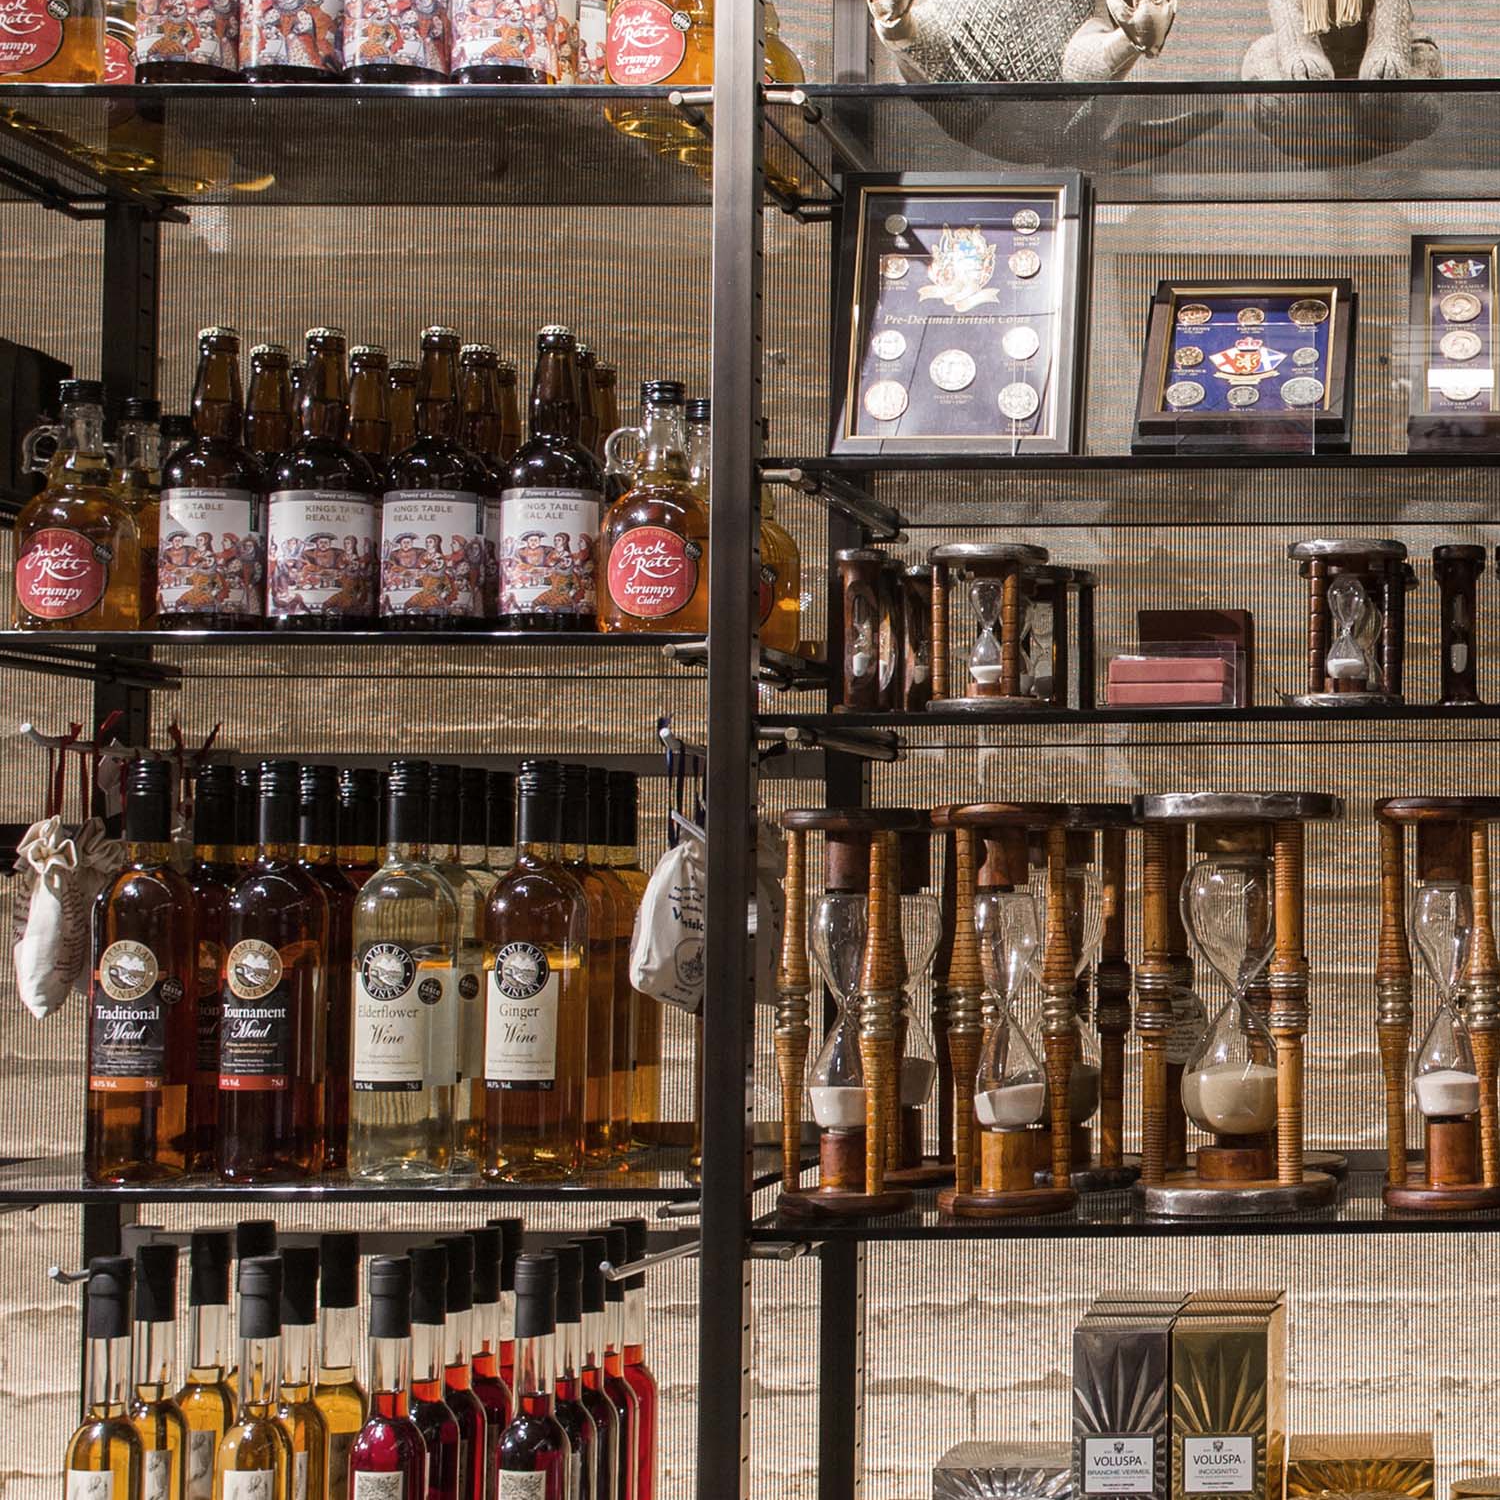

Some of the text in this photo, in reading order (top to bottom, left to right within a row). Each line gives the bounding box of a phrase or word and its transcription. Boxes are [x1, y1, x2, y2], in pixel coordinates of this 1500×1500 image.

[612, 10, 655, 41] Jack
[615, 53, 662, 68] Scrumpy
[624, 66, 648, 75] Cider
[884, 315, 954, 326] Pre-Decimal
[956, 315, 995, 326] British
[428, 491, 456, 499] London
[191, 502, 225, 512] TABLE
[304, 504, 337, 513] KINGS
[422, 504, 454, 514] TABLE
[550, 502, 580, 512] TABLE
[304, 513, 333, 522] REAL
[416, 513, 437, 522] ALE
[545, 511, 565, 520] ALE
[25, 542, 76, 570] Jack
[618, 540, 669, 569] Jack
[33, 559, 89, 583] Ratt
[627, 555, 681, 581] Ratt
[29, 583, 83, 600] Scrumpy
[623, 581, 676, 598] Scrumpy
[41, 596, 68, 608] Cider
[636, 595, 662, 605] Cider
[365, 944, 411, 964] LYME BAY
[498, 943, 545, 963] LYME BAY
[366, 983, 407, 999] WINERY
[500, 981, 541, 997] WINERY
[95, 1005, 160, 1020] Traditional
[223, 1003, 287, 1019] Tournament
[358, 1004, 419, 1019] Elderflower
[499, 1002, 540, 1020] Ginger
[104, 1020, 146, 1040] Mead
[230, 1019, 272, 1039] Mead
[370, 1024, 405, 1045] Wine
[503, 1023, 538, 1045] Wine
[1093, 1455, 1143, 1467] VOLUSPA
[1193, 1454, 1242, 1466] VOLUSPA
[1087, 1468, 1120, 1476] BRANCHE
[1198, 1467, 1239, 1475] INCOGNITO
